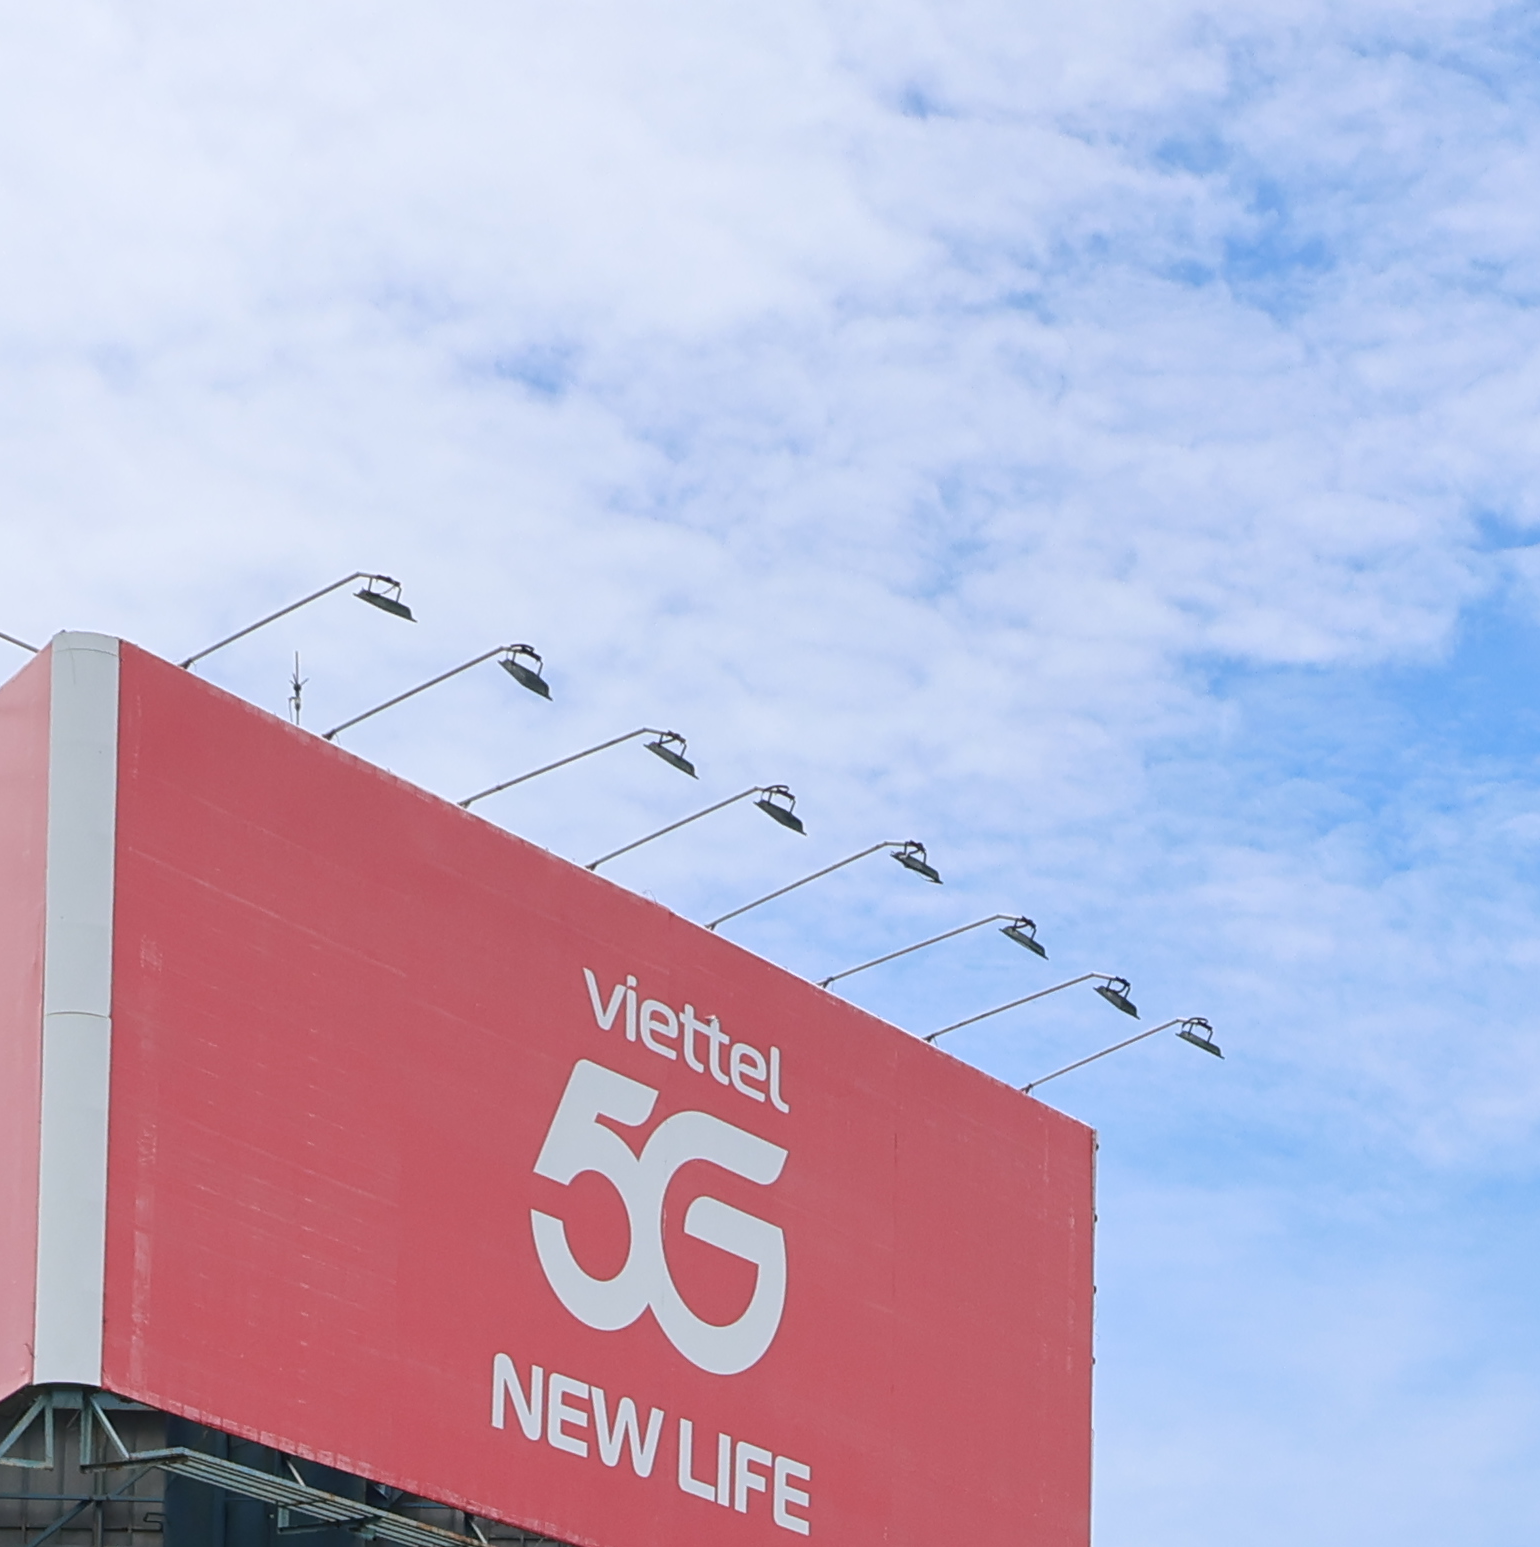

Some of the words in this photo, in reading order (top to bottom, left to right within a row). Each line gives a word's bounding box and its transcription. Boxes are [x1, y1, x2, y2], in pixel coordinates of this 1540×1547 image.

[582, 967, 789, 1113] viettel
[531, 1058, 789, 1375] 5G
[492, 1353, 665, 1478] NEW
[678, 1418, 811, 1536] LIFE
